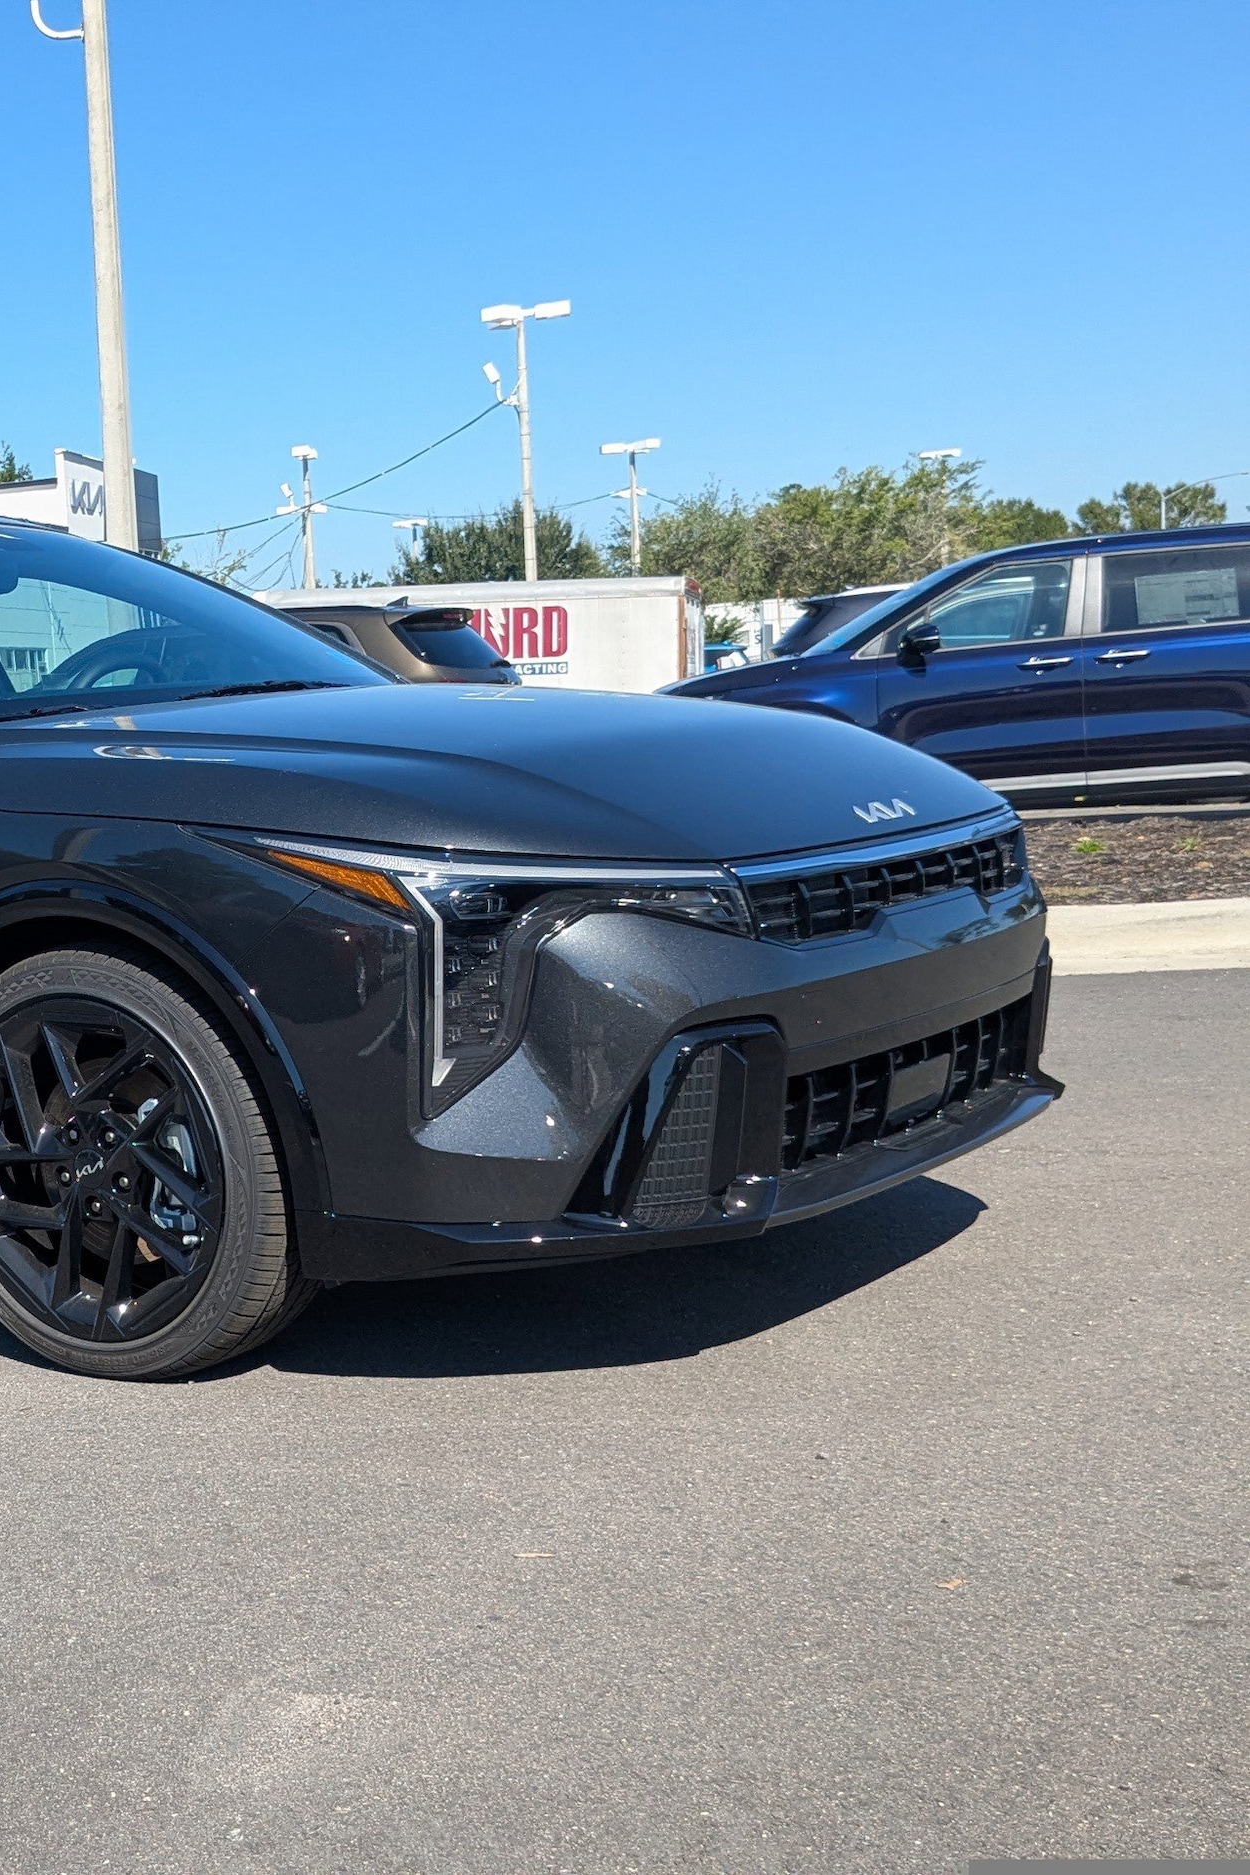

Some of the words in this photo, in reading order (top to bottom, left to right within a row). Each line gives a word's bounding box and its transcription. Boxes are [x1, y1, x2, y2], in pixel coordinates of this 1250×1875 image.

[515, 663, 567, 675] ACTING
[853, 799, 917, 823] KIA
[76, 1160, 104, 1178] KIA
